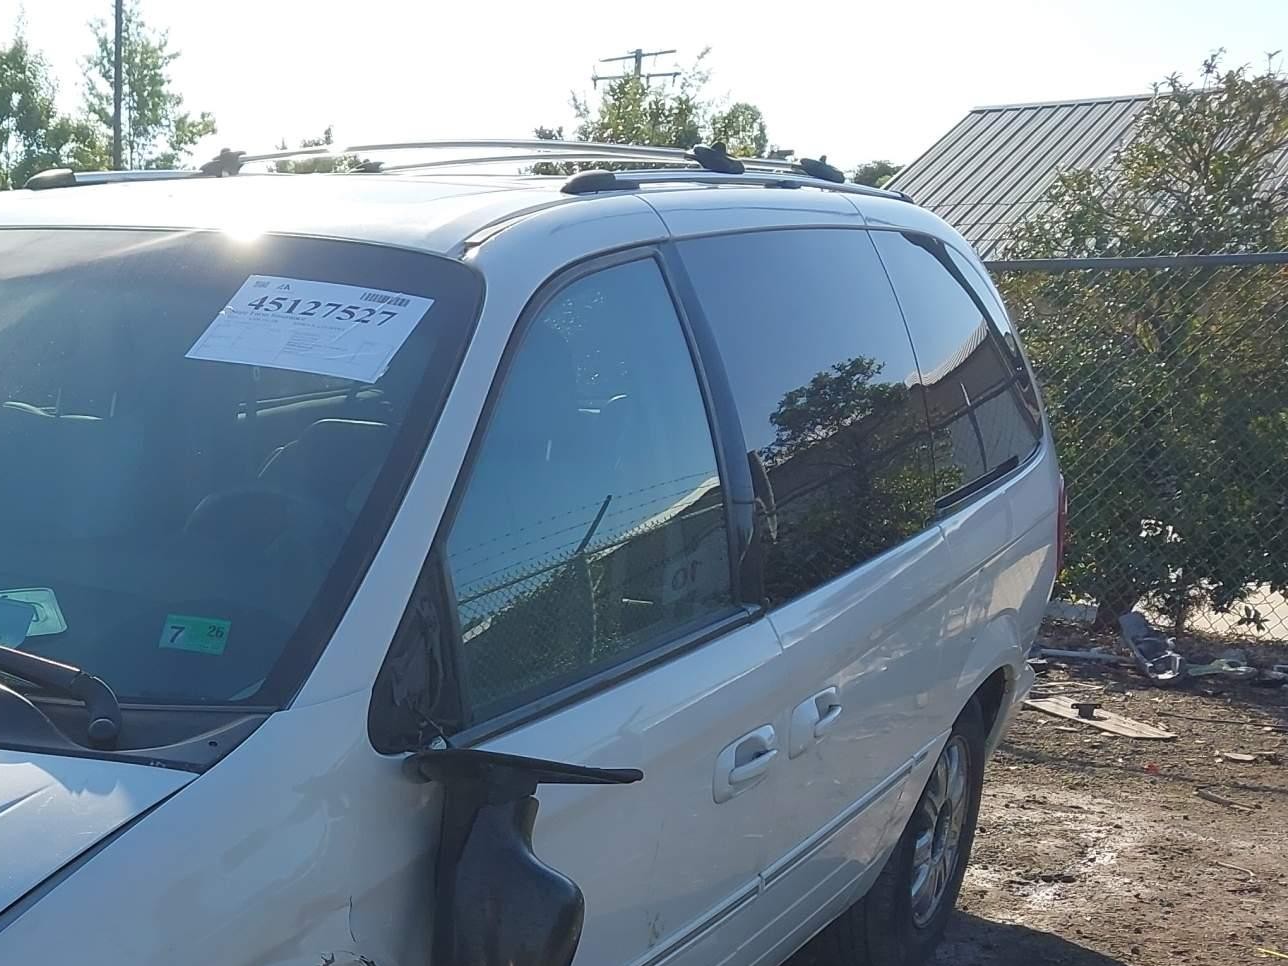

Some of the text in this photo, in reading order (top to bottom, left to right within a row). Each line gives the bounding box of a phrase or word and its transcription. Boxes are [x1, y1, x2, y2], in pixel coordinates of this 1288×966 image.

[248, 294, 398, 327] 45127527
[169, 624, 225, 643] 7 26
